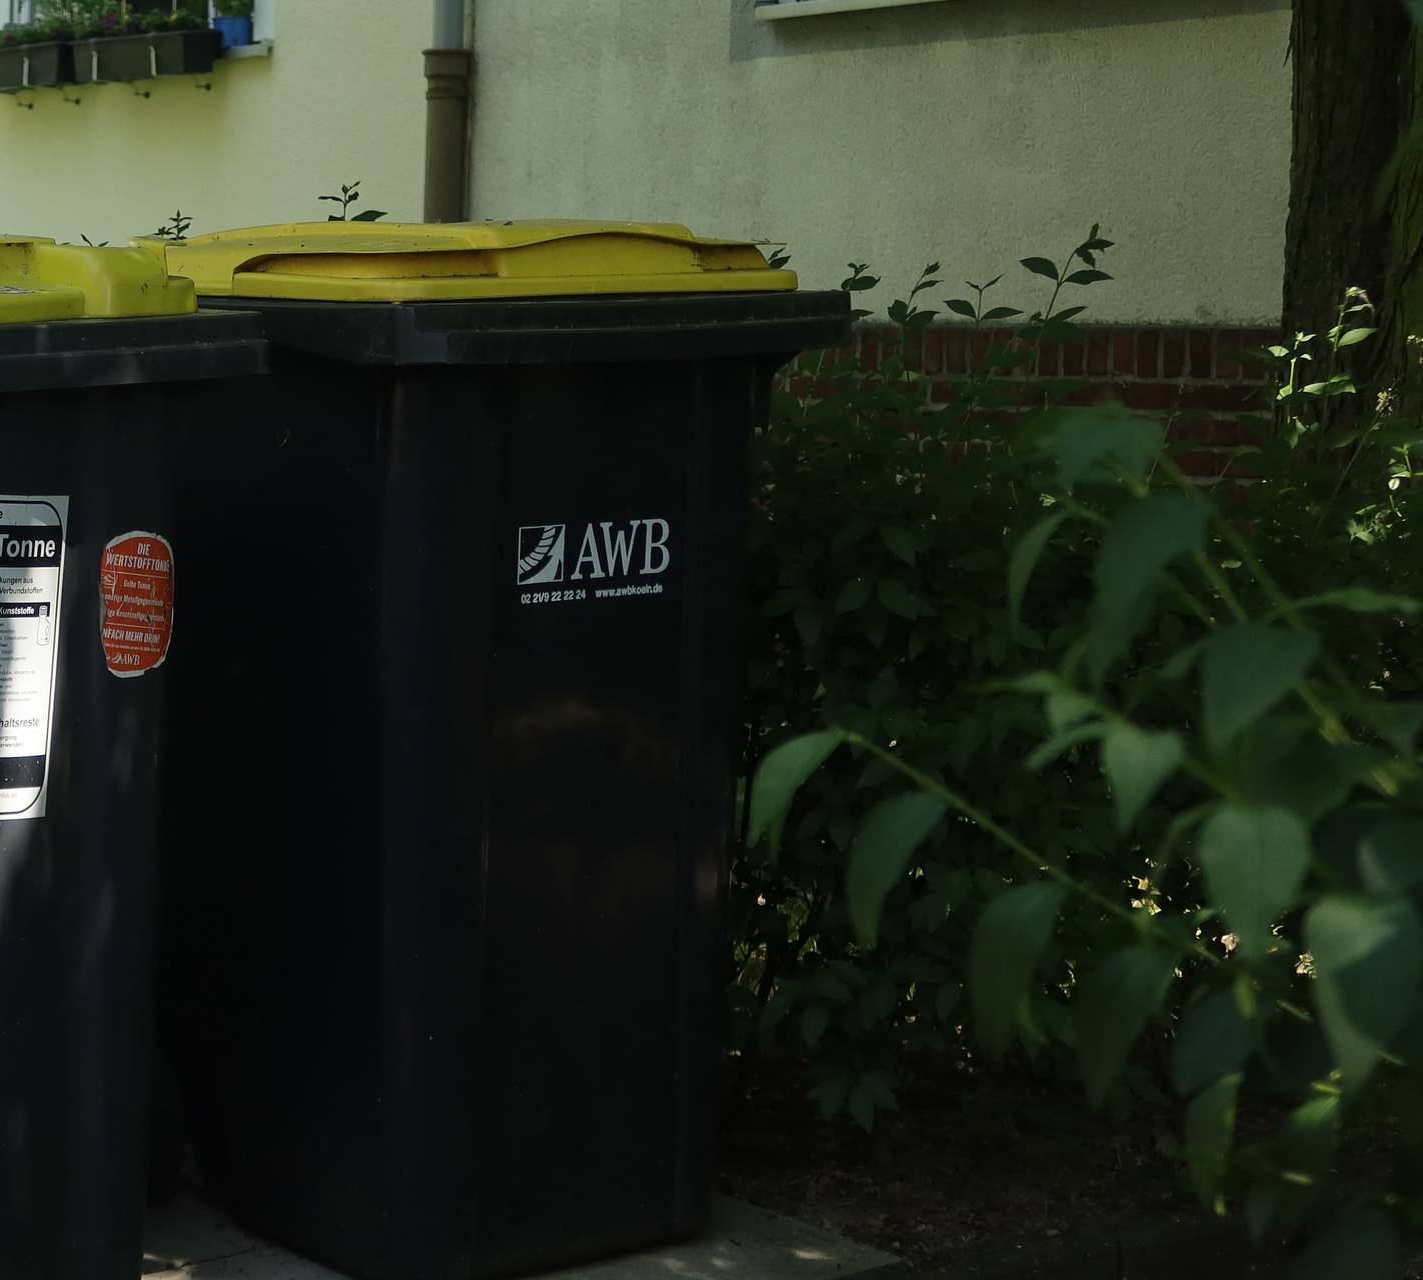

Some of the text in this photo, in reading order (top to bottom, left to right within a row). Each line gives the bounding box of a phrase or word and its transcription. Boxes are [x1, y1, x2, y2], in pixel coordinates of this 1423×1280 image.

[137, 543, 151, 556] DIE
[570, 519, 670, 580] AWB
[521, 593, 532, 604] 02
[551, 591, 562, 601] 22
[563, 590, 574, 600] 22
[575, 589, 586, 600] 24
[125, 630, 144, 643] MEHR
[123, 654, 141, 666] AWB
